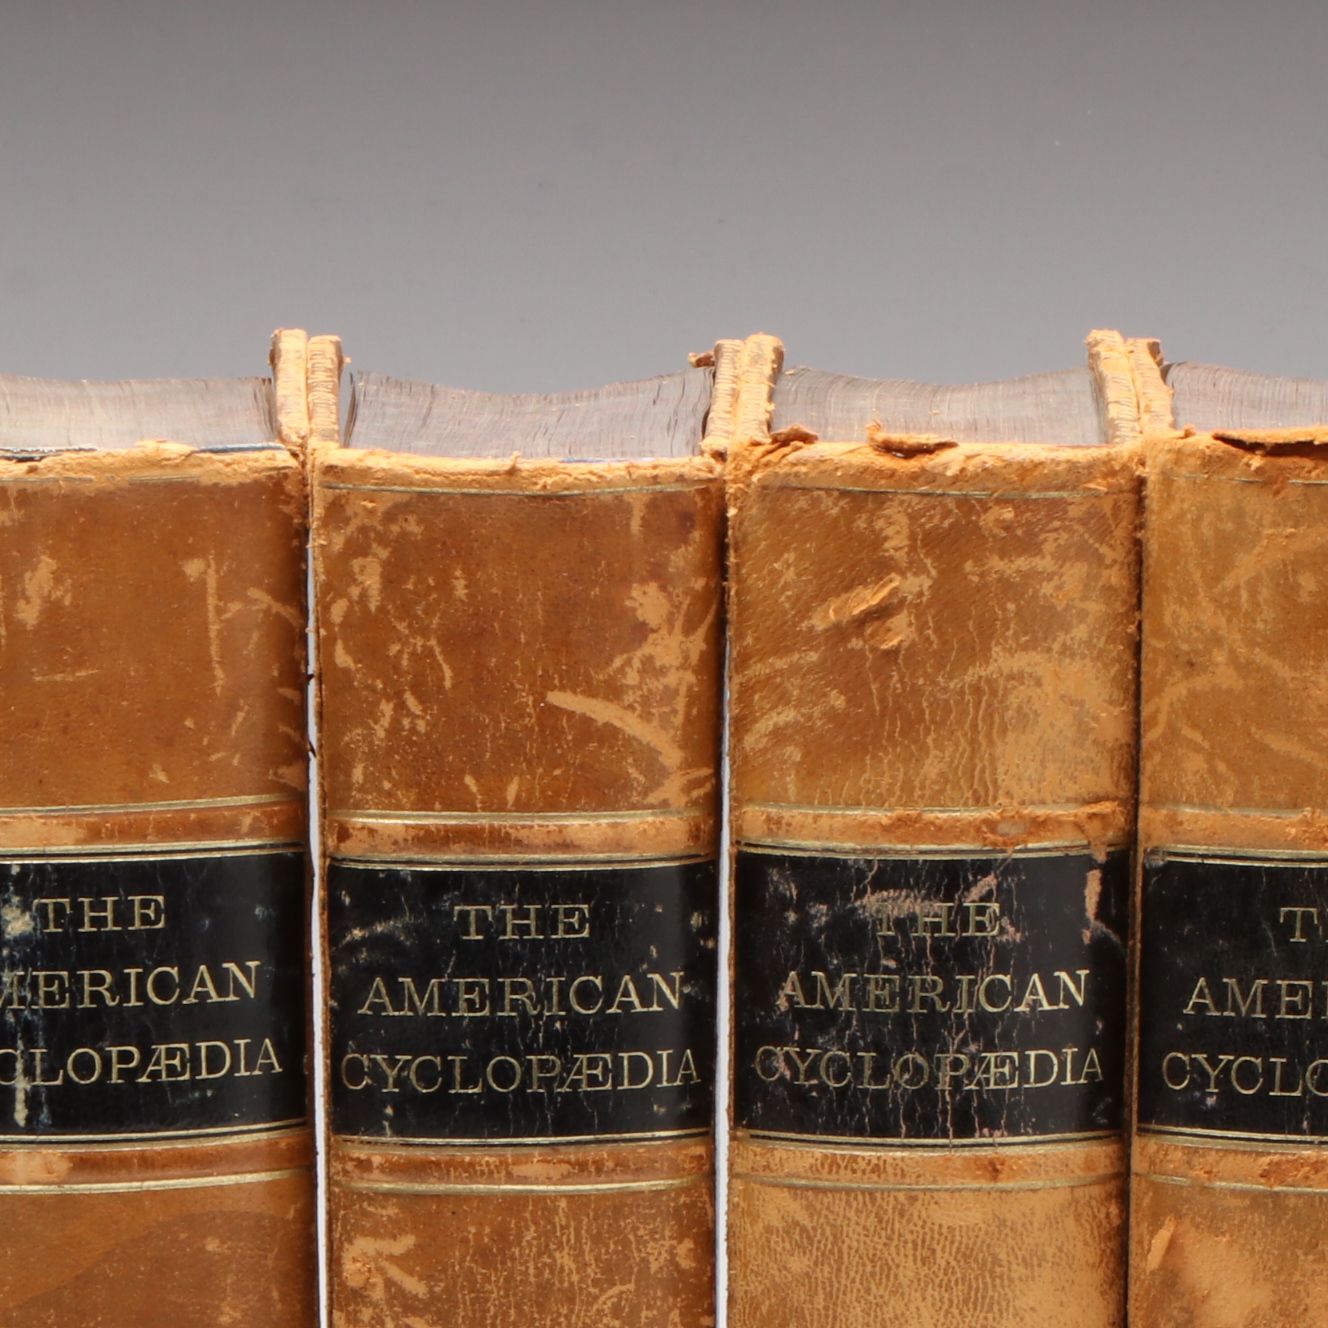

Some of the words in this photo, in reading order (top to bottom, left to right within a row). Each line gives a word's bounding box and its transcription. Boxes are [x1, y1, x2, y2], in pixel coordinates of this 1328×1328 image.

[32, 895, 166, 933] THE
[453, 904, 590, 940] THE
[873, 902, 1001, 937] THE
[357, 972, 685, 1017] AMERICAN
[777, 969, 1090, 1013] AMERICAN
